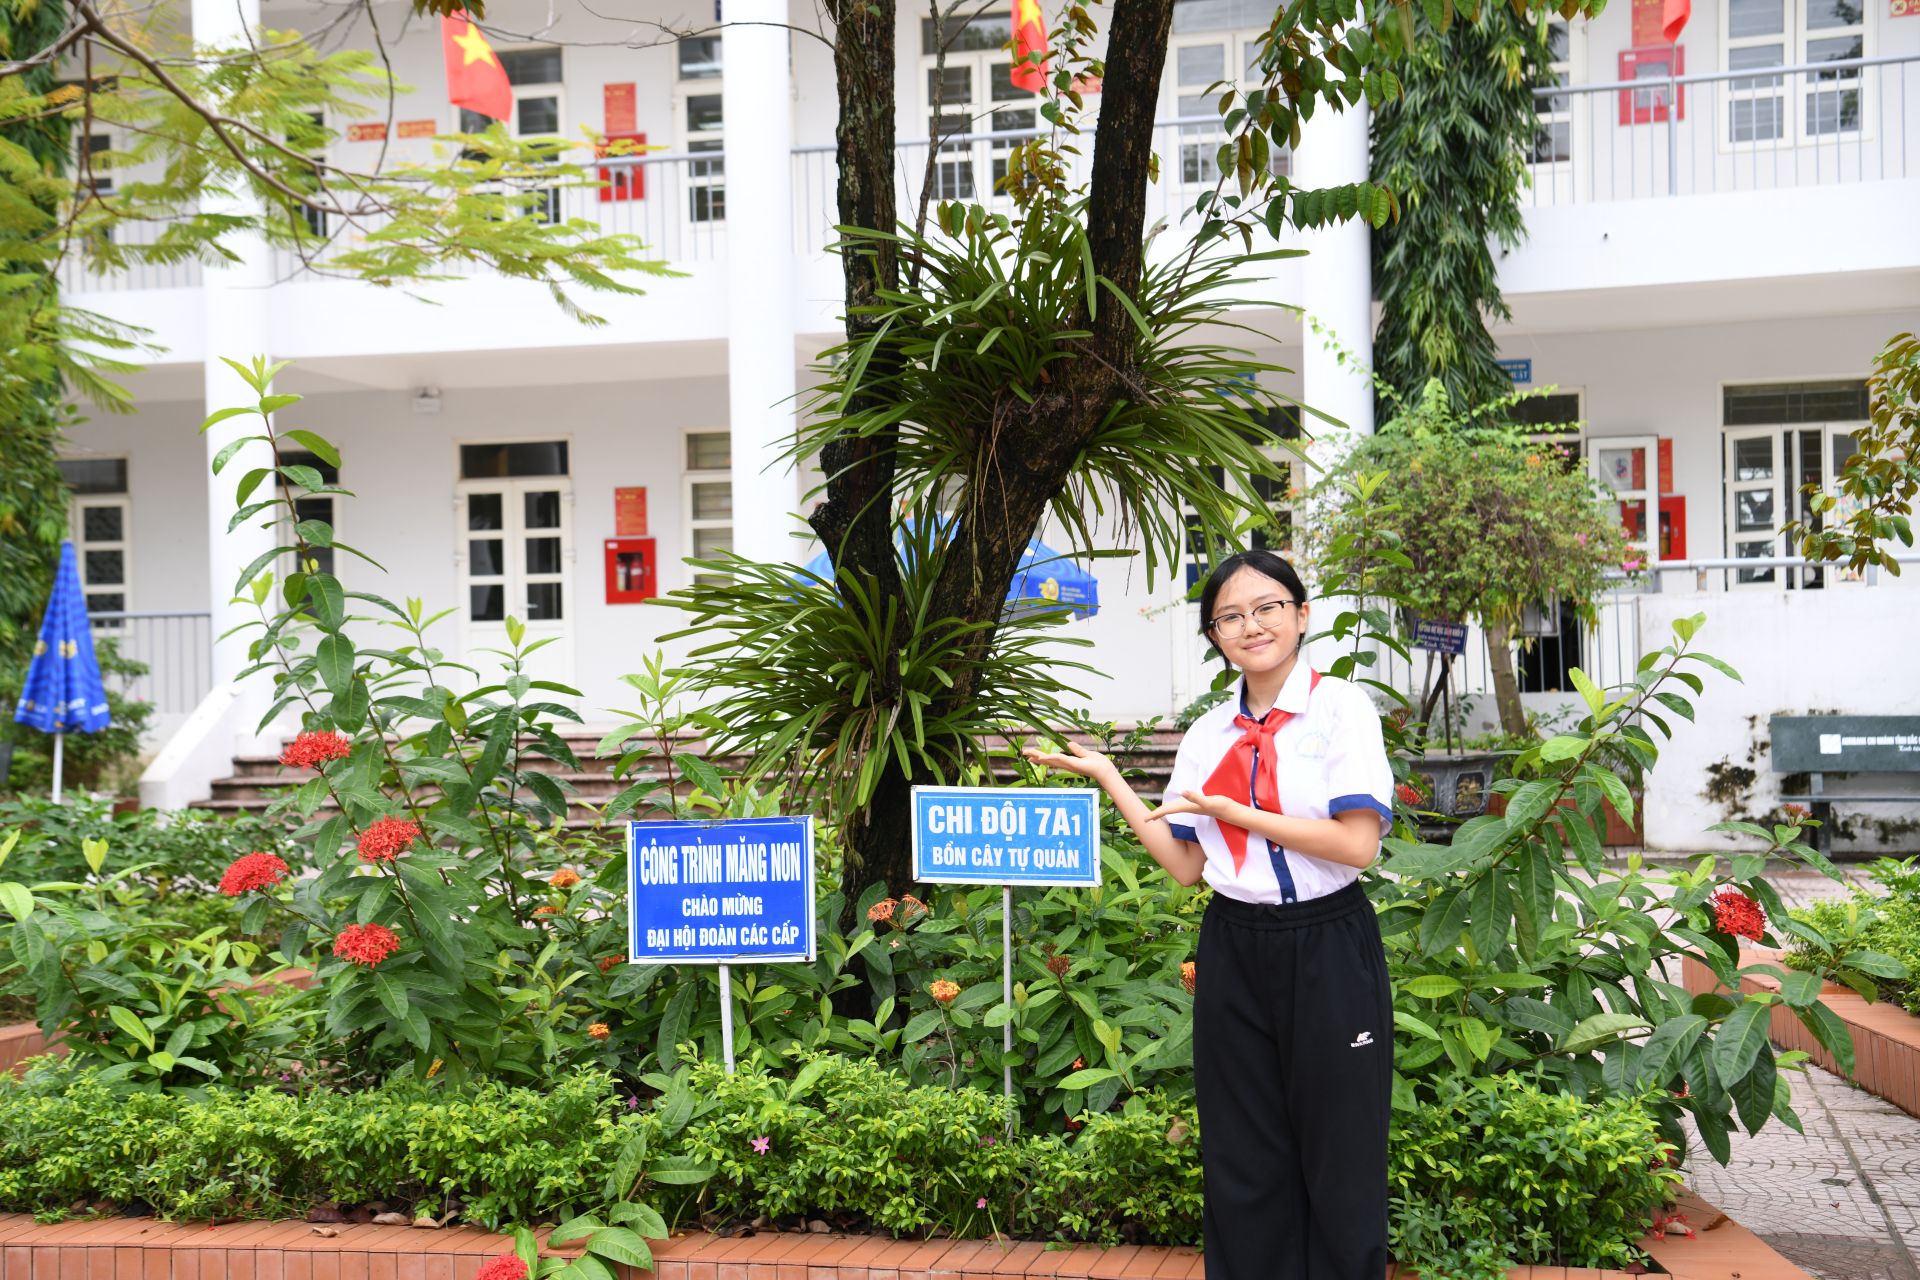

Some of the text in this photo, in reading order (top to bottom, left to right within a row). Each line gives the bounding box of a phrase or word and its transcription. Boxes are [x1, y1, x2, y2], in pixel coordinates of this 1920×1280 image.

[928, 800, 1081, 841] CHI ĐỘI 7A1
[640, 835, 801, 886] CÔNG TRÌNH MĂNG NON
[932, 840, 1080, 872] BỒN CÂY TỰ QUẢN
[682, 892, 763, 917] CHÀO MỪNG
[647, 919, 800, 952] ĐẠI HỘI ĐOÀN CÁC CẤP
